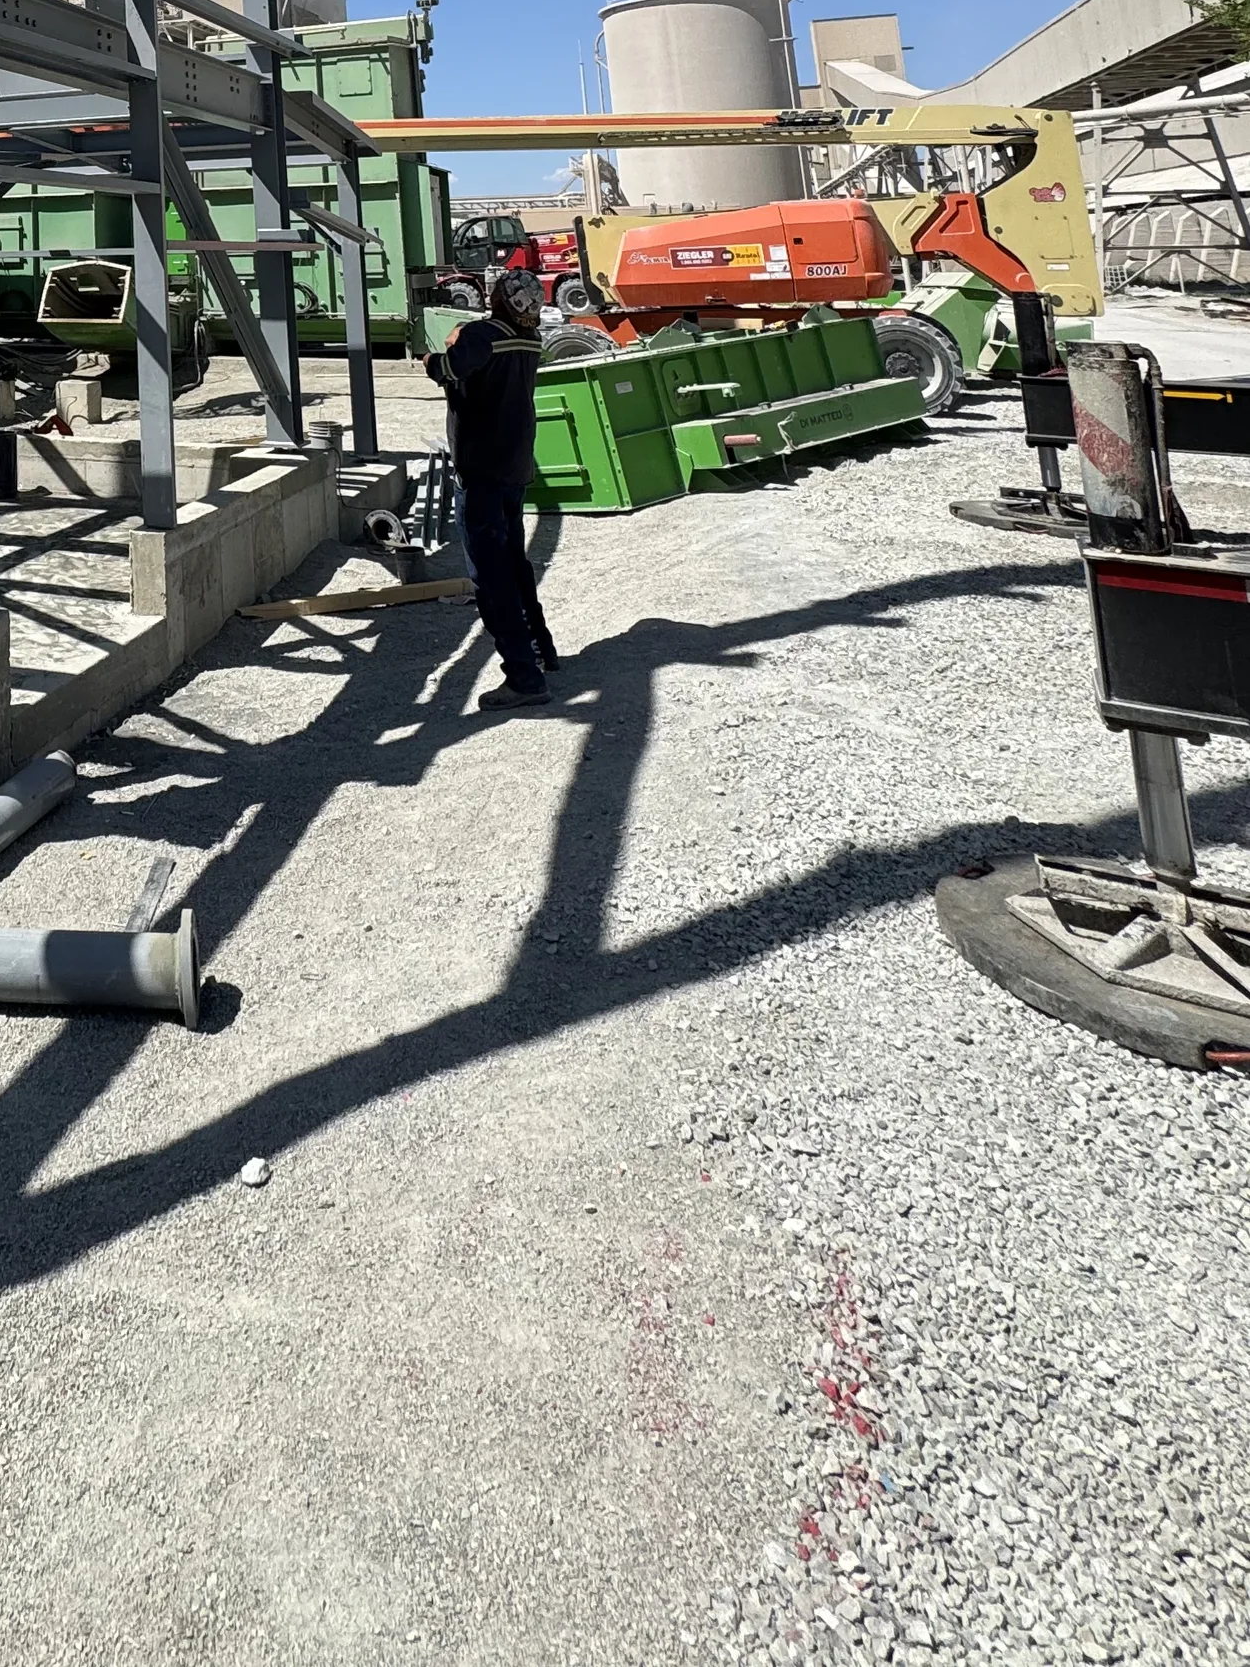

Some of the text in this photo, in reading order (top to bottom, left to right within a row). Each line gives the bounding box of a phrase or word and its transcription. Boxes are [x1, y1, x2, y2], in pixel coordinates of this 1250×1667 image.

[835, 109, 894, 126] IFT
[676, 250, 715, 260] ZIEGLER
[806, 265, 848, 277] 800AJ
